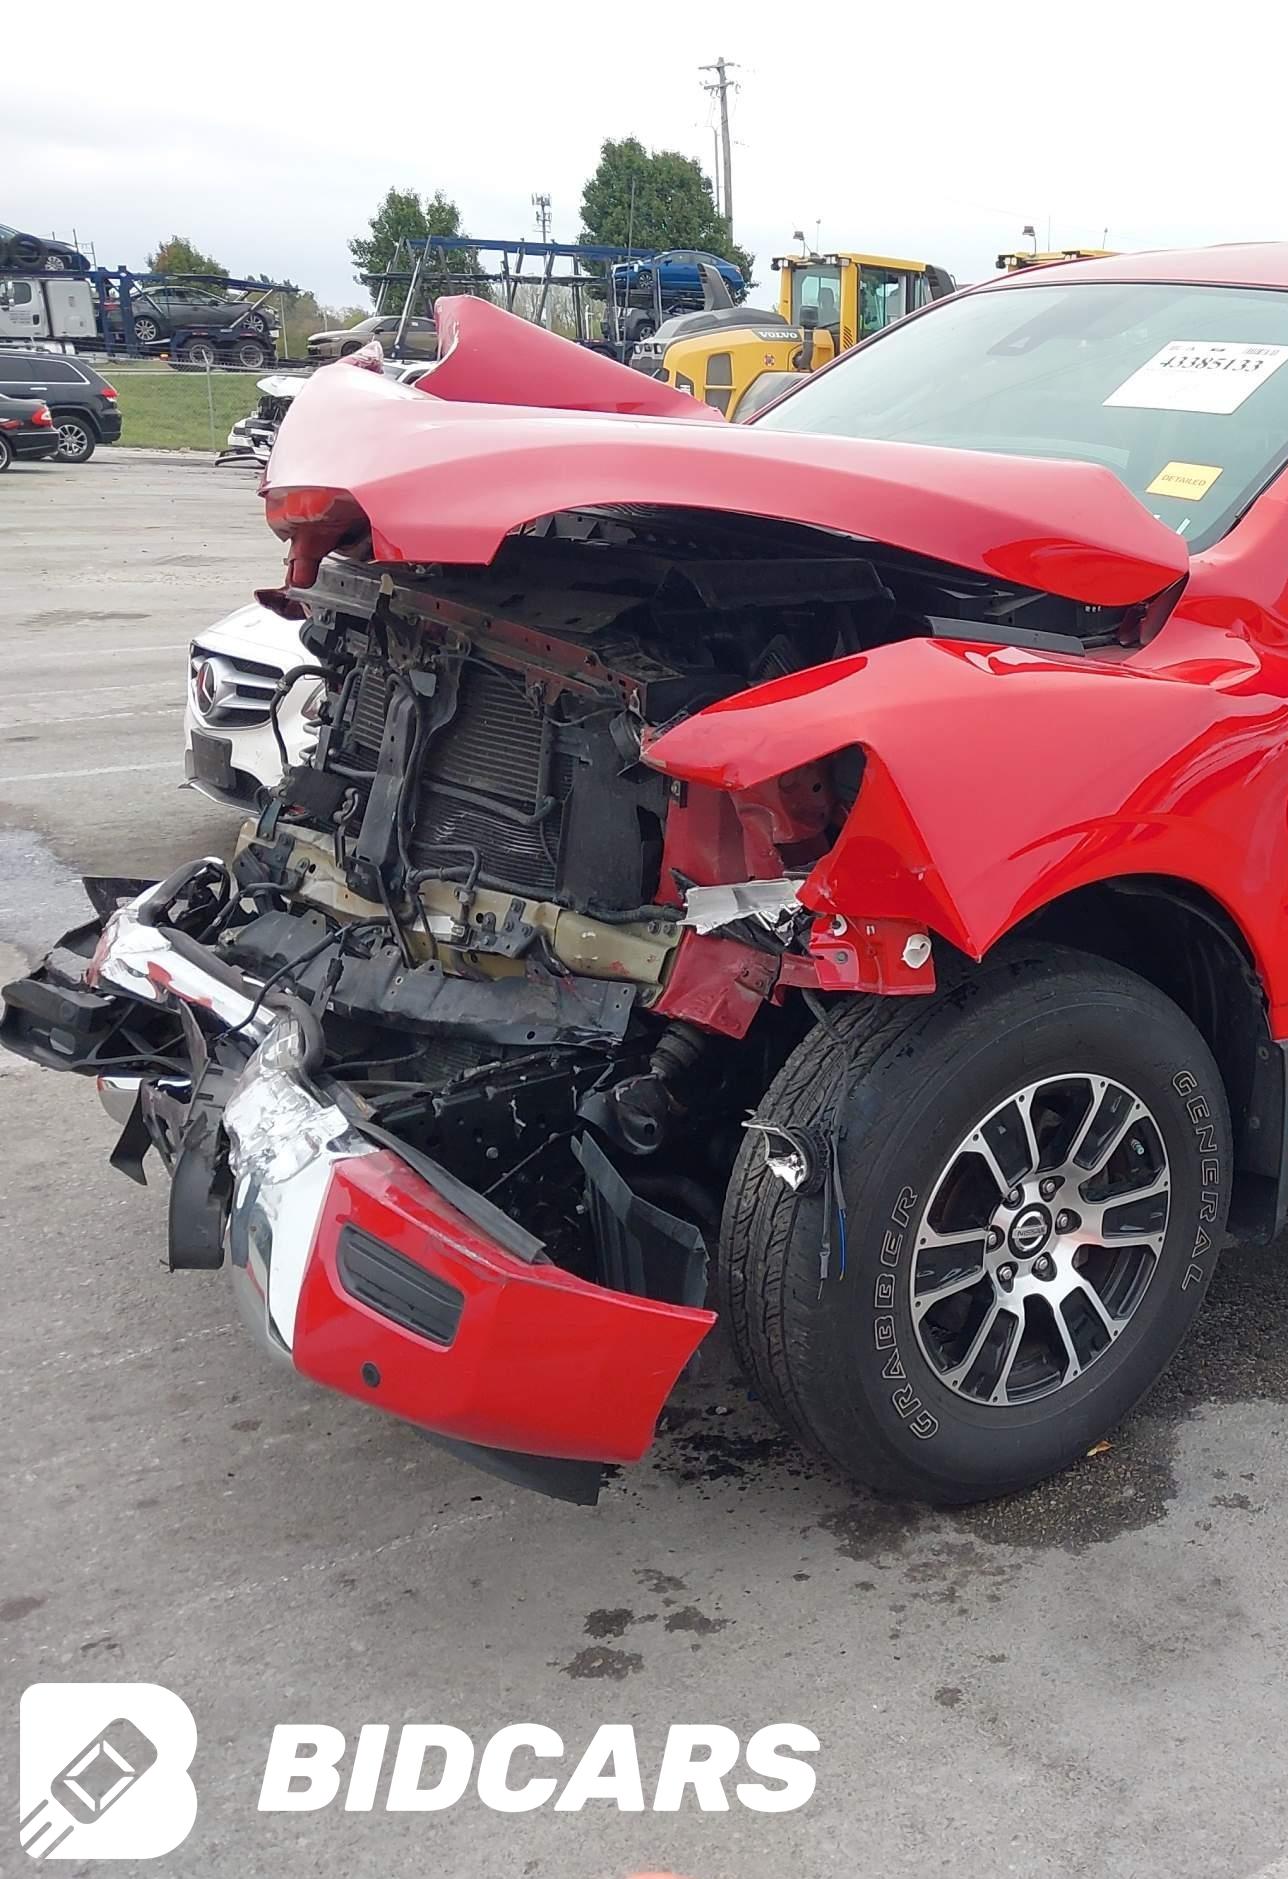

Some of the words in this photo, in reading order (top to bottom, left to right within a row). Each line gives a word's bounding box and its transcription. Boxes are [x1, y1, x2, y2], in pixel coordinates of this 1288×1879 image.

[758, 331, 798, 339] VOLVO
[1160, 356, 1264, 372] 43385133
[1161, 474, 1207, 487] DETAILED
[1172, 1069, 1227, 1291] GENERAL
[873, 1185, 940, 1440] GRABBER
